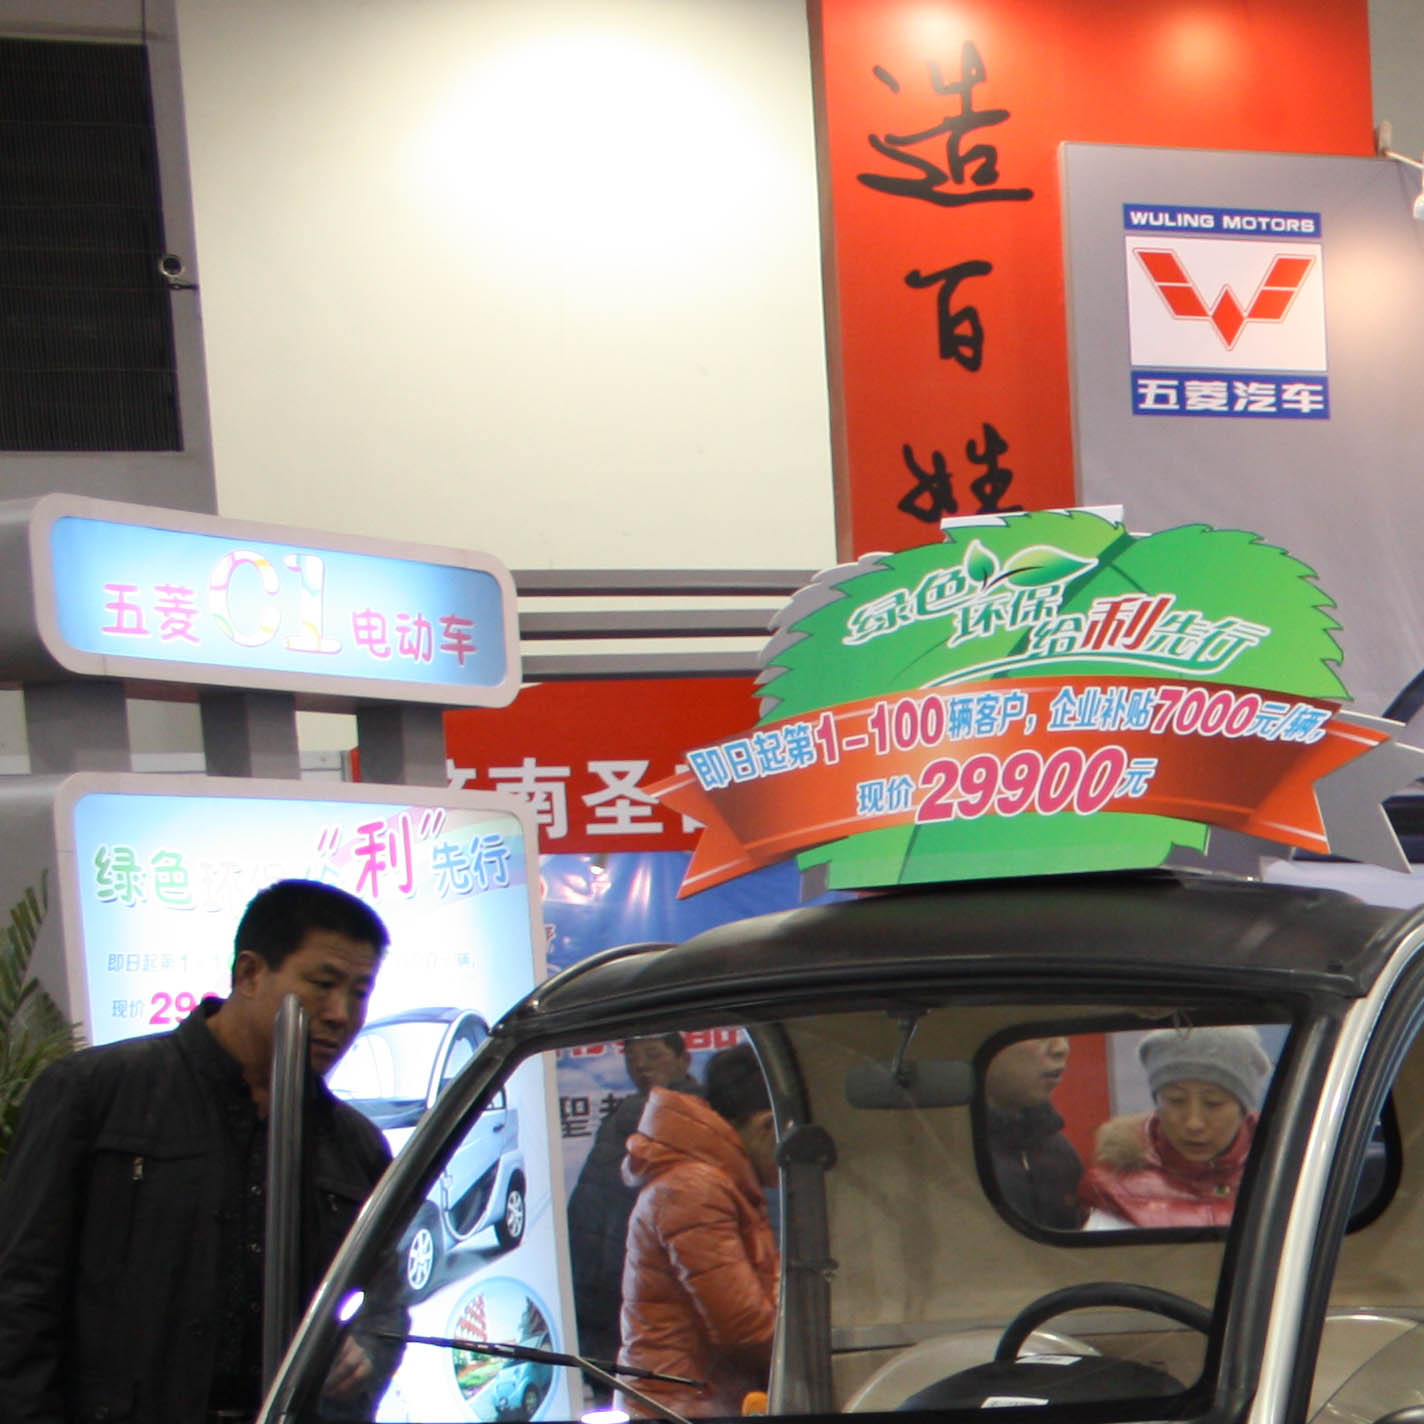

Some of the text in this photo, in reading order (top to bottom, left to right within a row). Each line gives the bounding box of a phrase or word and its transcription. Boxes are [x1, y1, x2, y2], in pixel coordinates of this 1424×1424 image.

[1129, 210, 1316, 234] WULING MOTORS
[1136, 378, 1325, 414] 五菱汽车
[101, 549, 477, 667] 五菱C1电动车
[842, 566, 976, 647] 绿色
[948, 586, 1064, 650] 环保
[1026, 595, 1272, 668] 给利先行
[856, 746, 1159, 824] 现价29900元
